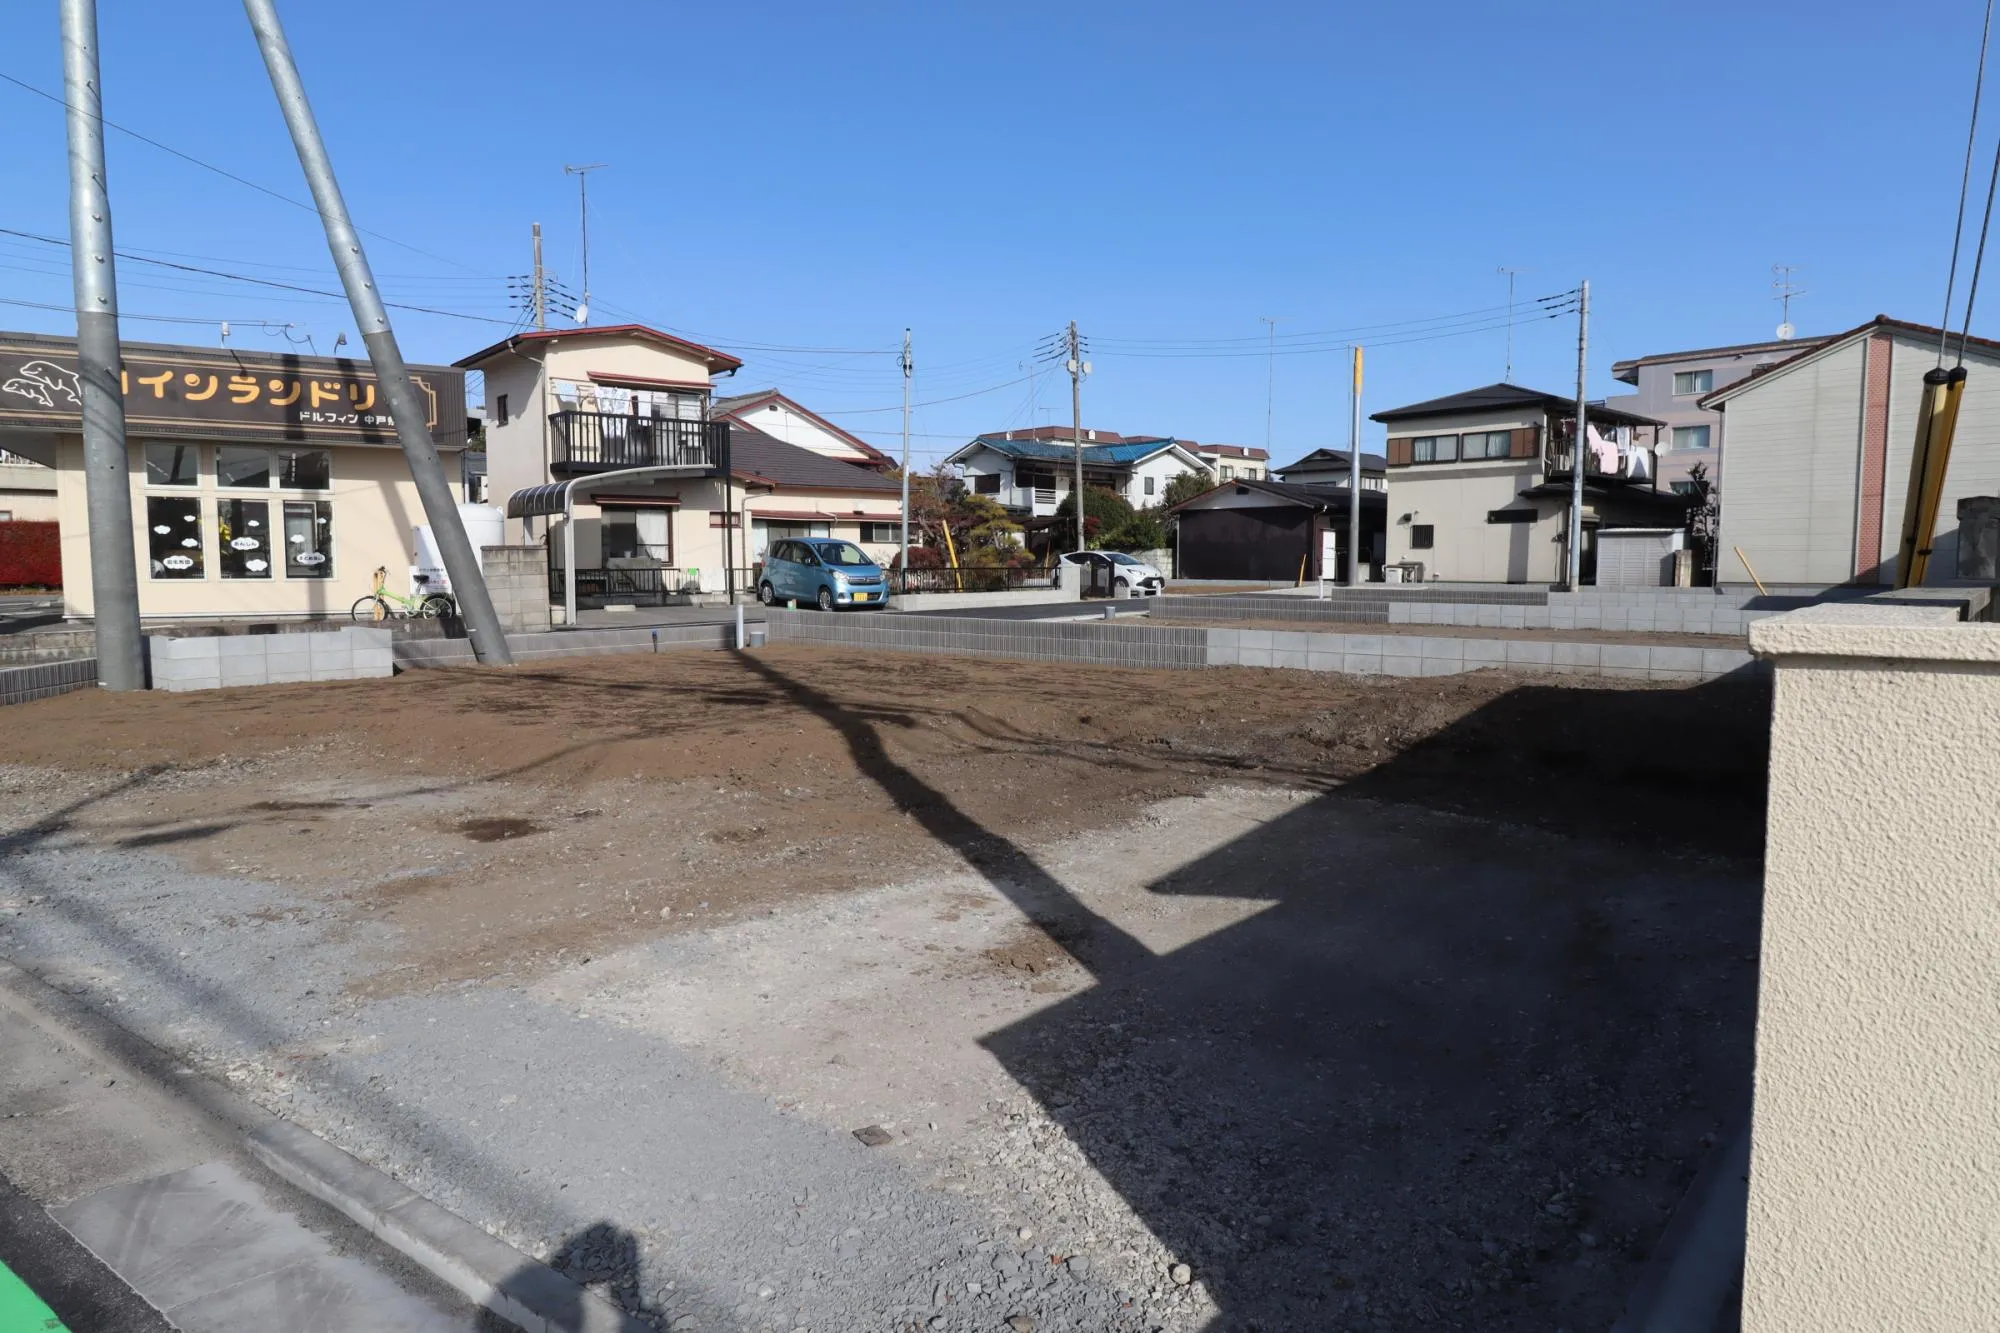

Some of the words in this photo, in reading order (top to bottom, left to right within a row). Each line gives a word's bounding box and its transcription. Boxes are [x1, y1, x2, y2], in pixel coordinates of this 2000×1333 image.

[300, 411, 358, 424] ドルフィン
